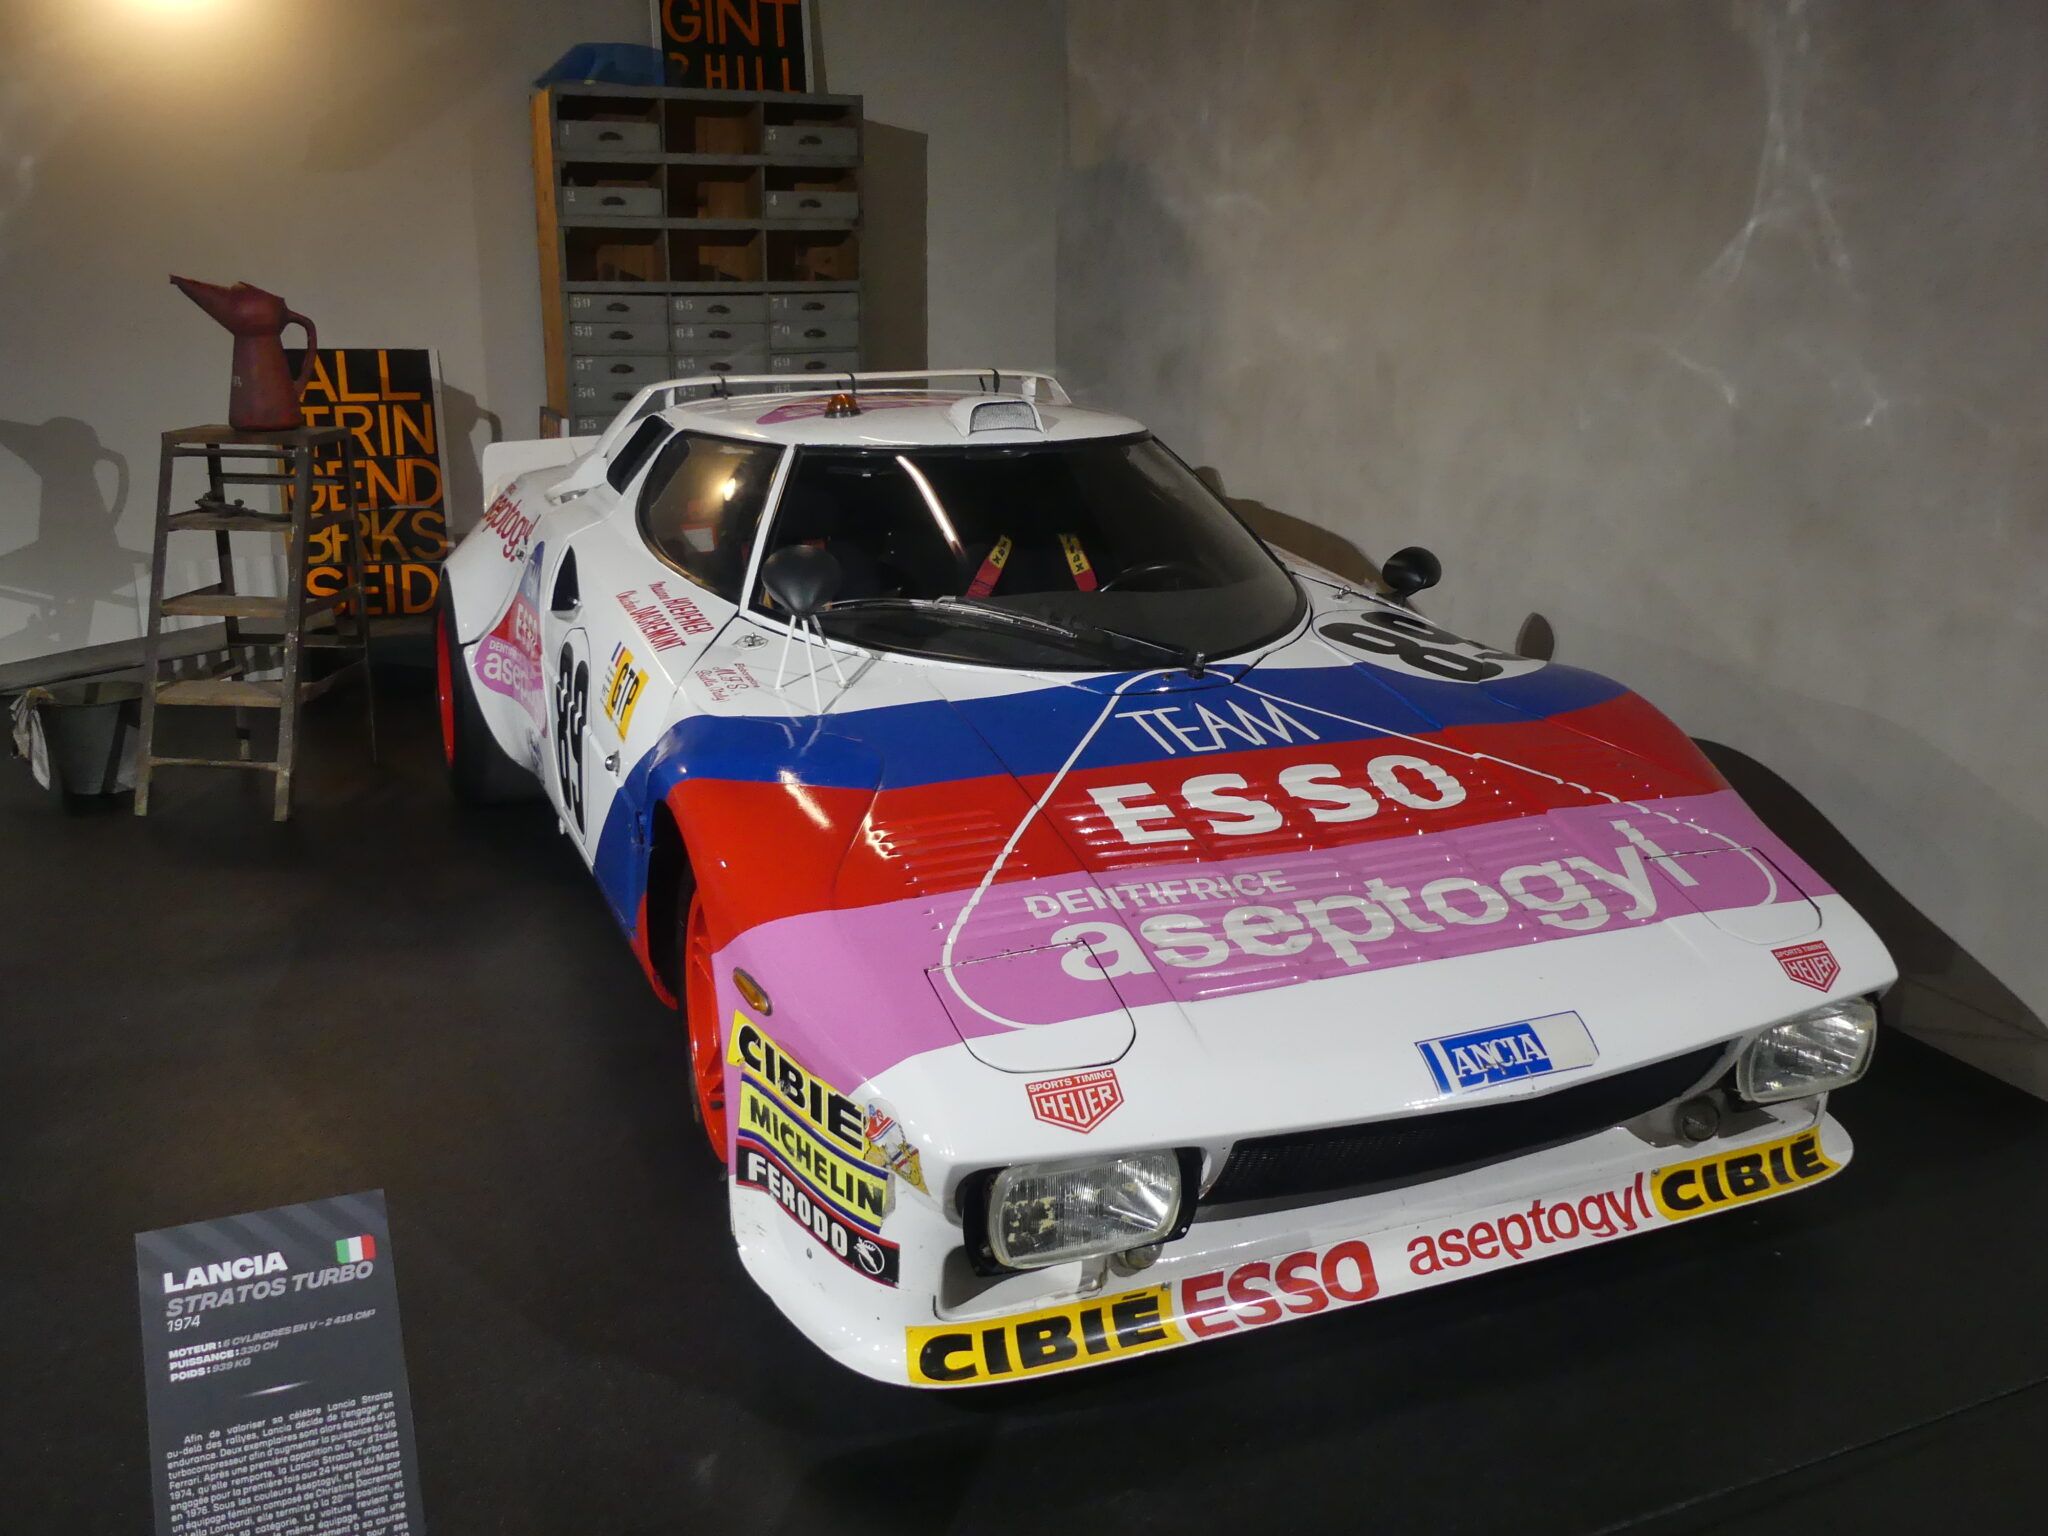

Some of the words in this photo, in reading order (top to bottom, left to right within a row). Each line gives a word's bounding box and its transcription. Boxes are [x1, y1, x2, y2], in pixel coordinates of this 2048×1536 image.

[662, 0, 799, 48] GINT
[300, 349, 421, 402] ALL
[630, 605, 687, 652] DACREMONT
[1115, 697, 1320, 755] TEAM
[1086, 754, 1467, 845] ESSO
[1024, 869, 1298, 920] DENTIFRICE
[1051, 819, 1700, 982] aseptogyl
[1787, 955, 1834, 984] HEUER
[1028, 1078, 1073, 1093] SPORTS
[1074, 1069, 1114, 1084] TIMING
[1427, 1033, 1549, 1095] LANCIA
[1040, 1085, 1115, 1125] HEUER
[750, 1094, 884, 1218] MICHELIN
[748, 1152, 848, 1257] FERODO
[1406, 1172, 1653, 1276] aseptogyl
[164, 1252, 288, 1293] LANCIA
[166, 1278, 286, 1317] STRATOS
[292, 1261, 373, 1291] TURBO
[1181, 1239, 1379, 1338] ESSO
[168, 1315, 200, 1332] 1974
[234, 1357, 251, 1368] KG
